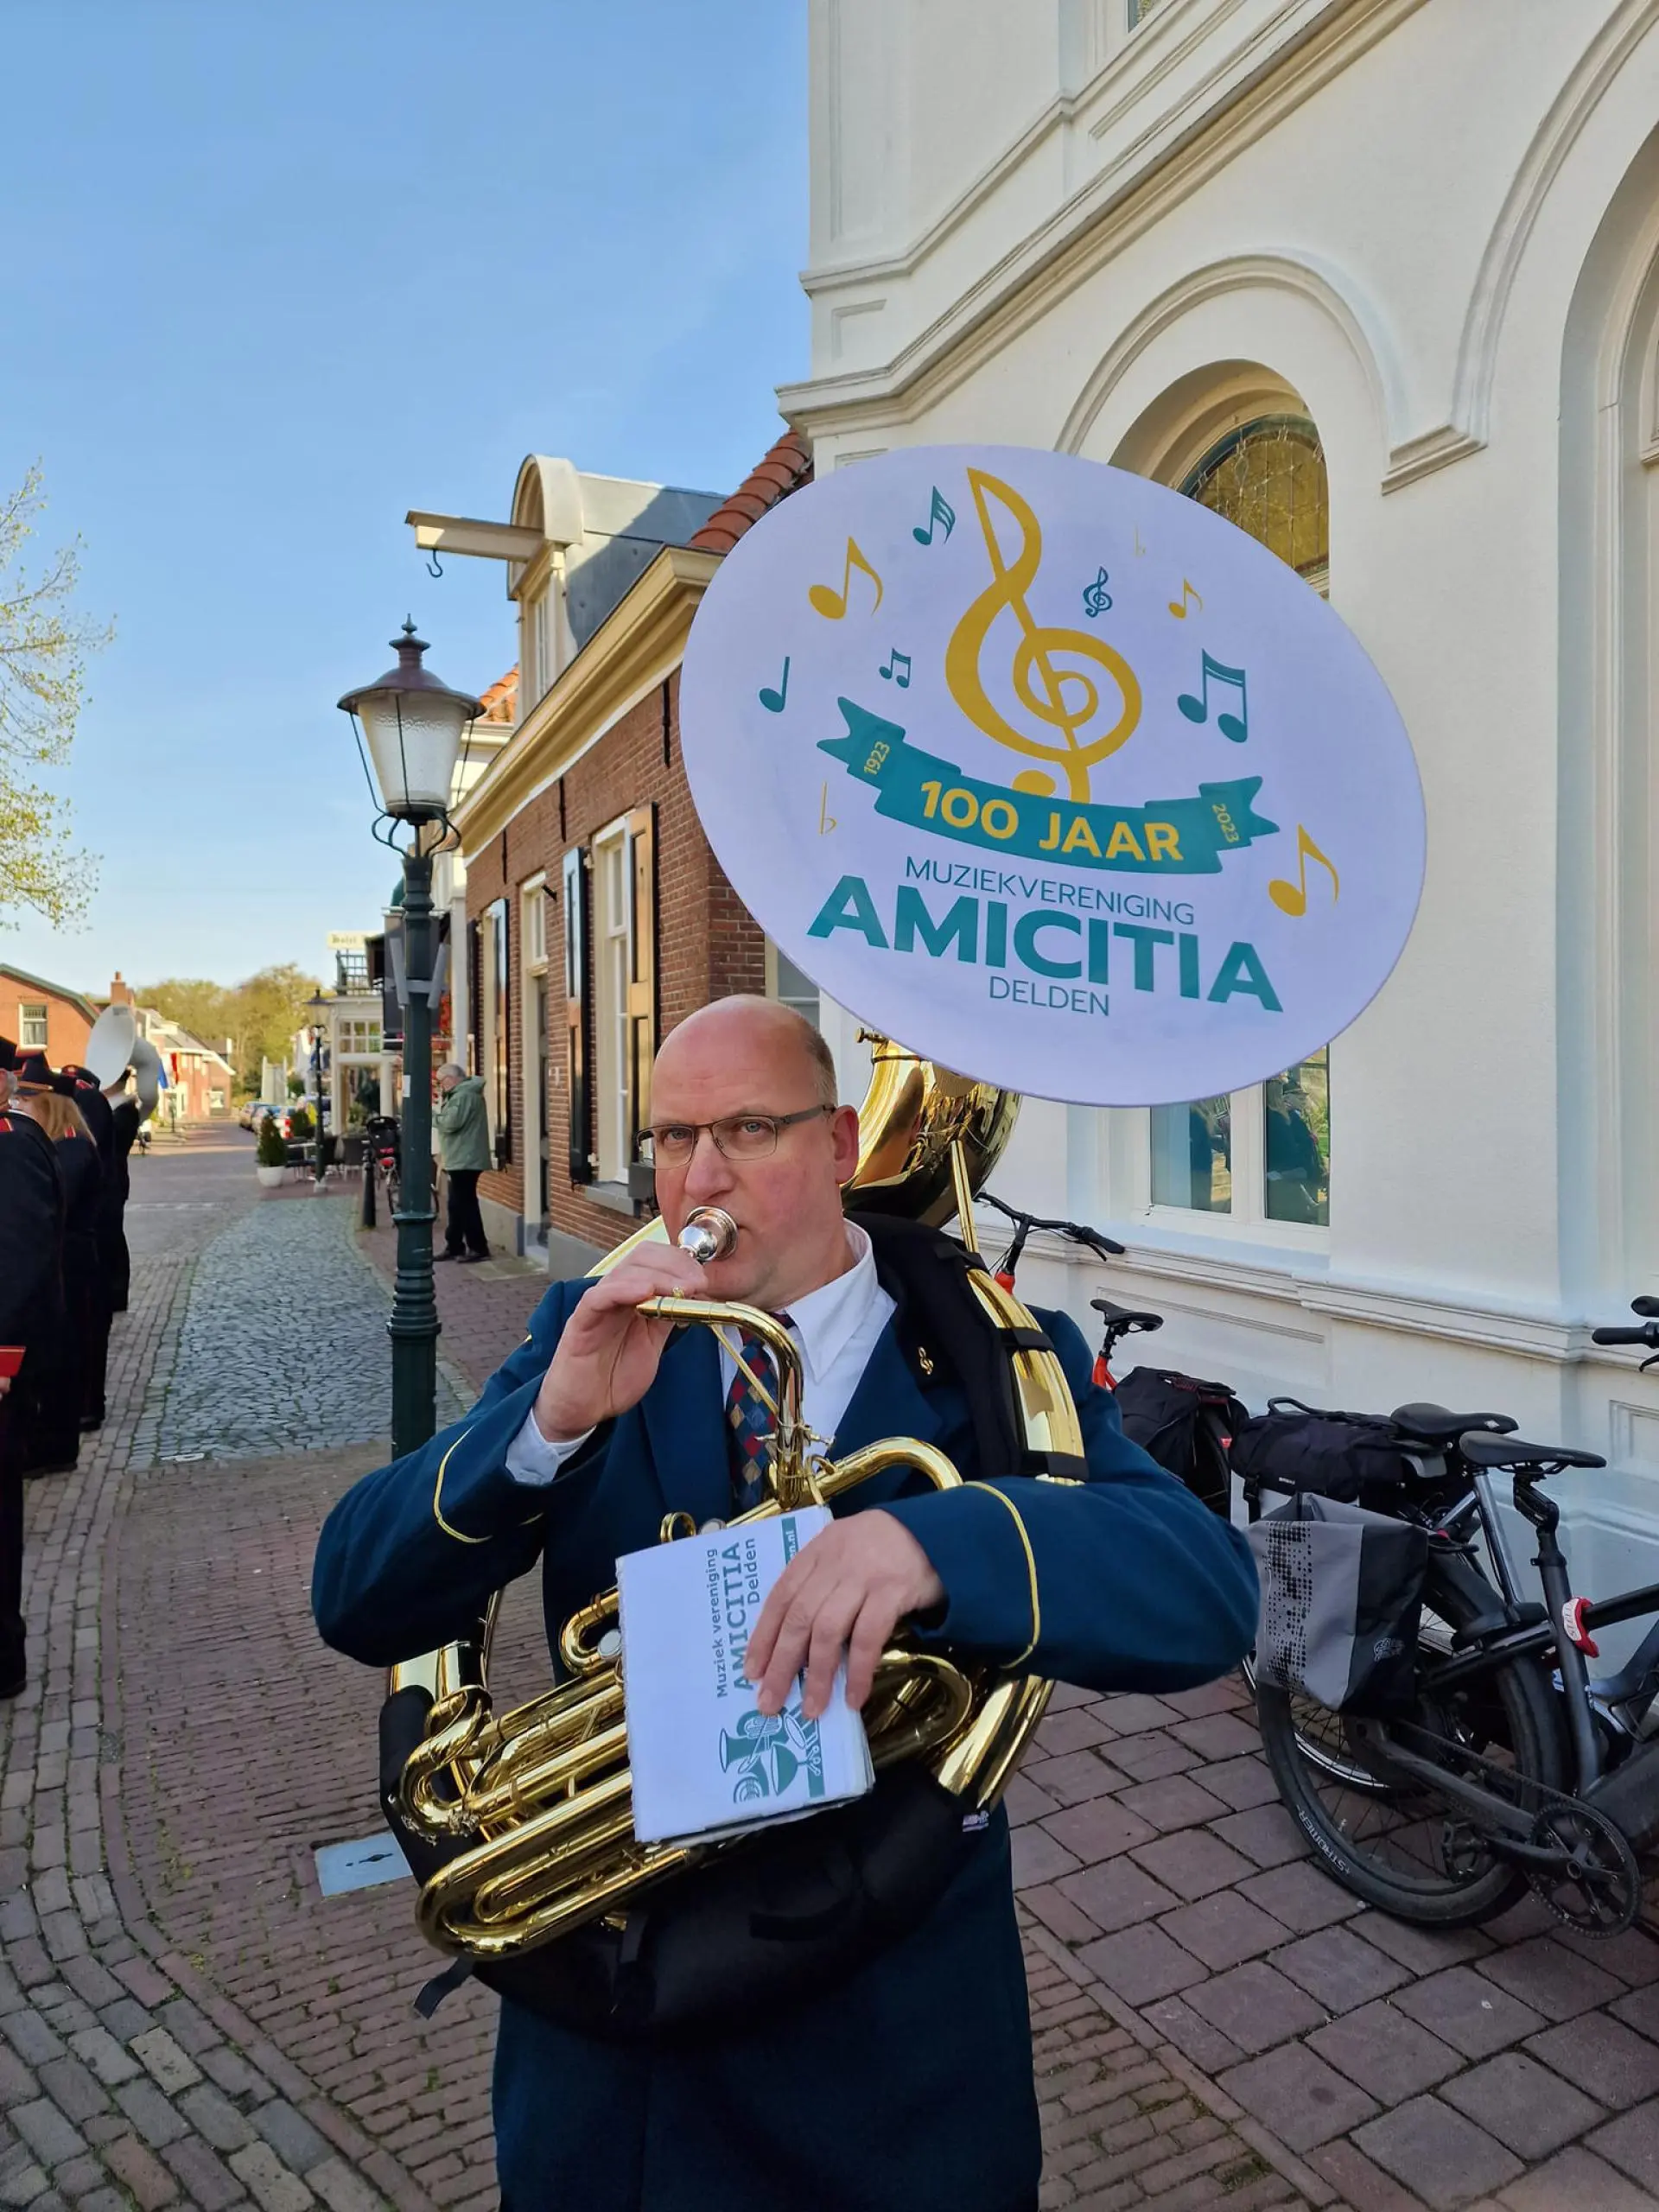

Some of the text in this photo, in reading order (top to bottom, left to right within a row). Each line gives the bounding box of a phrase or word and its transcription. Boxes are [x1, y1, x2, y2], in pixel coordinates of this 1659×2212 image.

[863, 741, 890, 775] 1923
[920, 781, 1184, 861] 100 JAAR
[1211, 803, 1239, 843] 2023
[905, 855, 1194, 925] MUZIEKVERENIGING
[805, 874, 1284, 1014] AMICITIA
[989, 976, 1109, 1017] DELDEN
[743, 1537, 760, 1605] Delden
[705, 1548, 728, 1698] Muziek vereniging
[721, 1541, 753, 1691] AMICITIA
